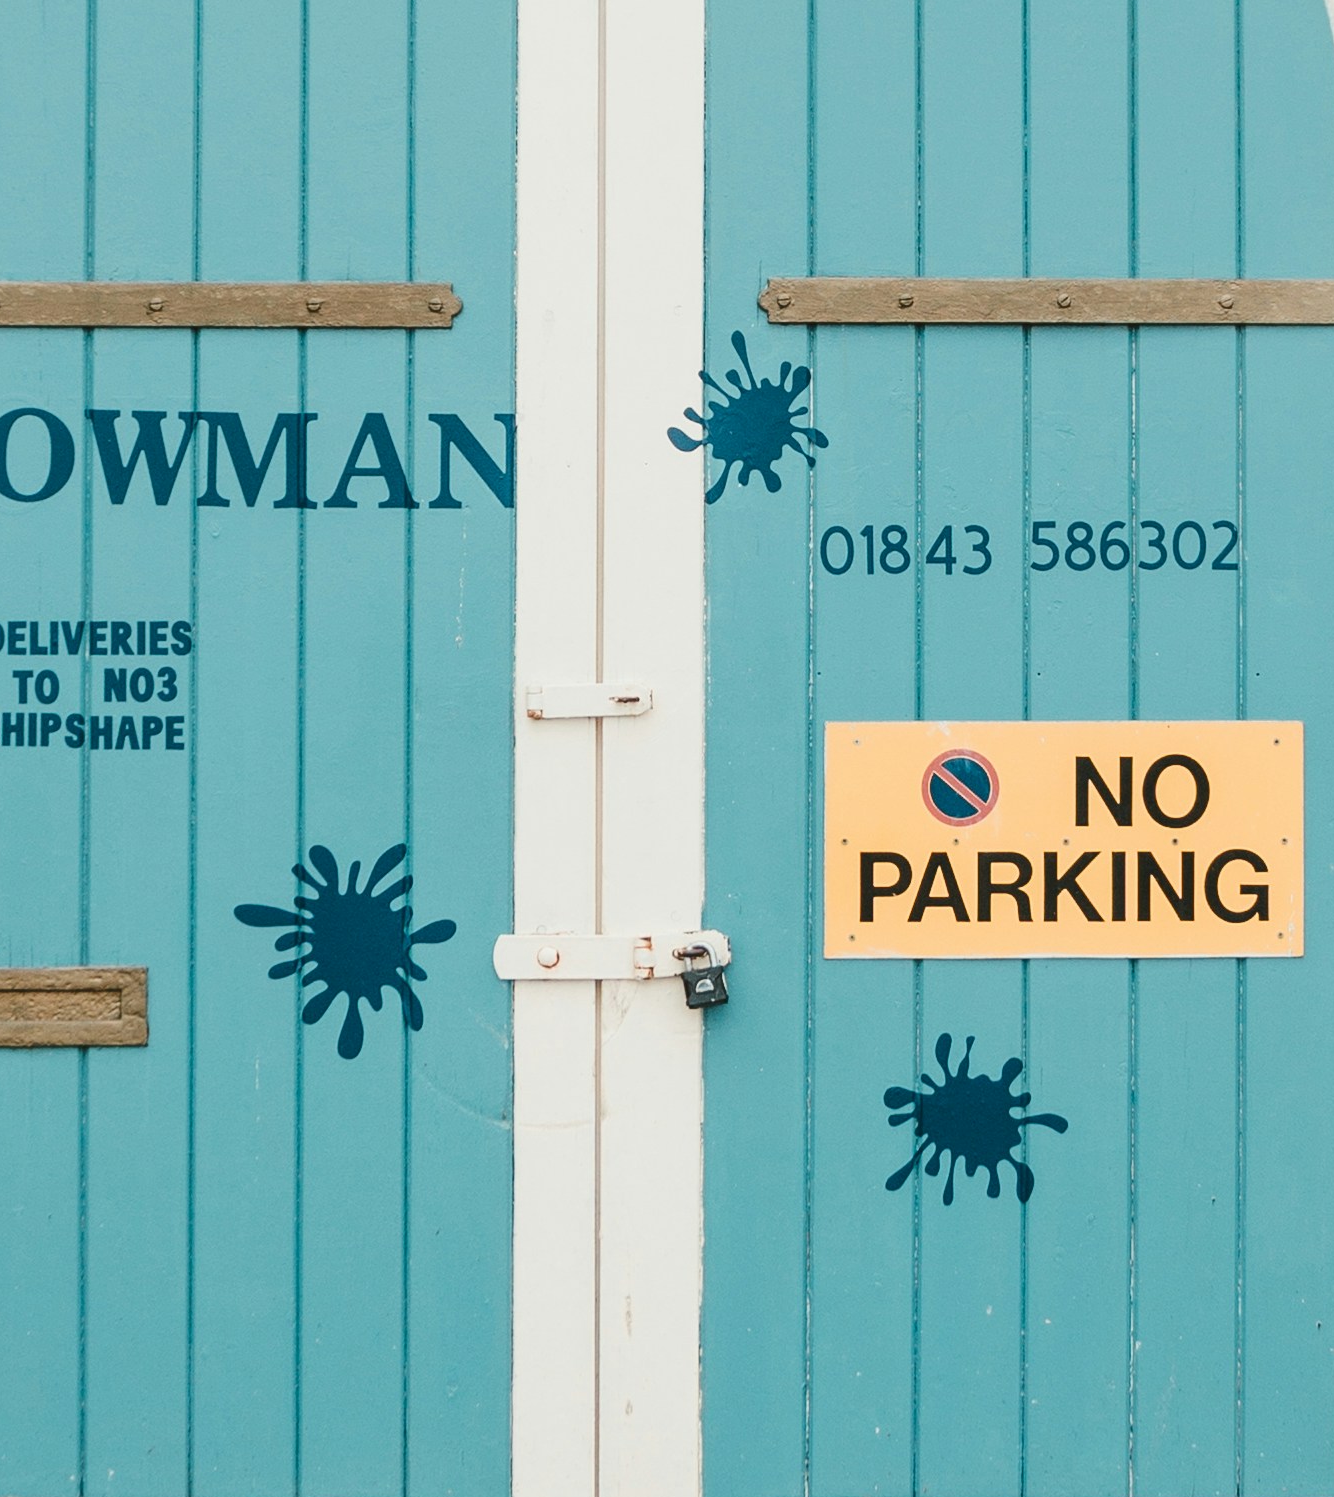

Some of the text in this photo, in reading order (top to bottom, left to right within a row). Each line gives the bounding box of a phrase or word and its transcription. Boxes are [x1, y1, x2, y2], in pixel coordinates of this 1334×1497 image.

[1029, 520, 1241, 573] 586302
[12, 666, 178, 705] TO NO3
[1075, 754, 1210, 829] NO
[859, 848, 1270, 924] PARKING
